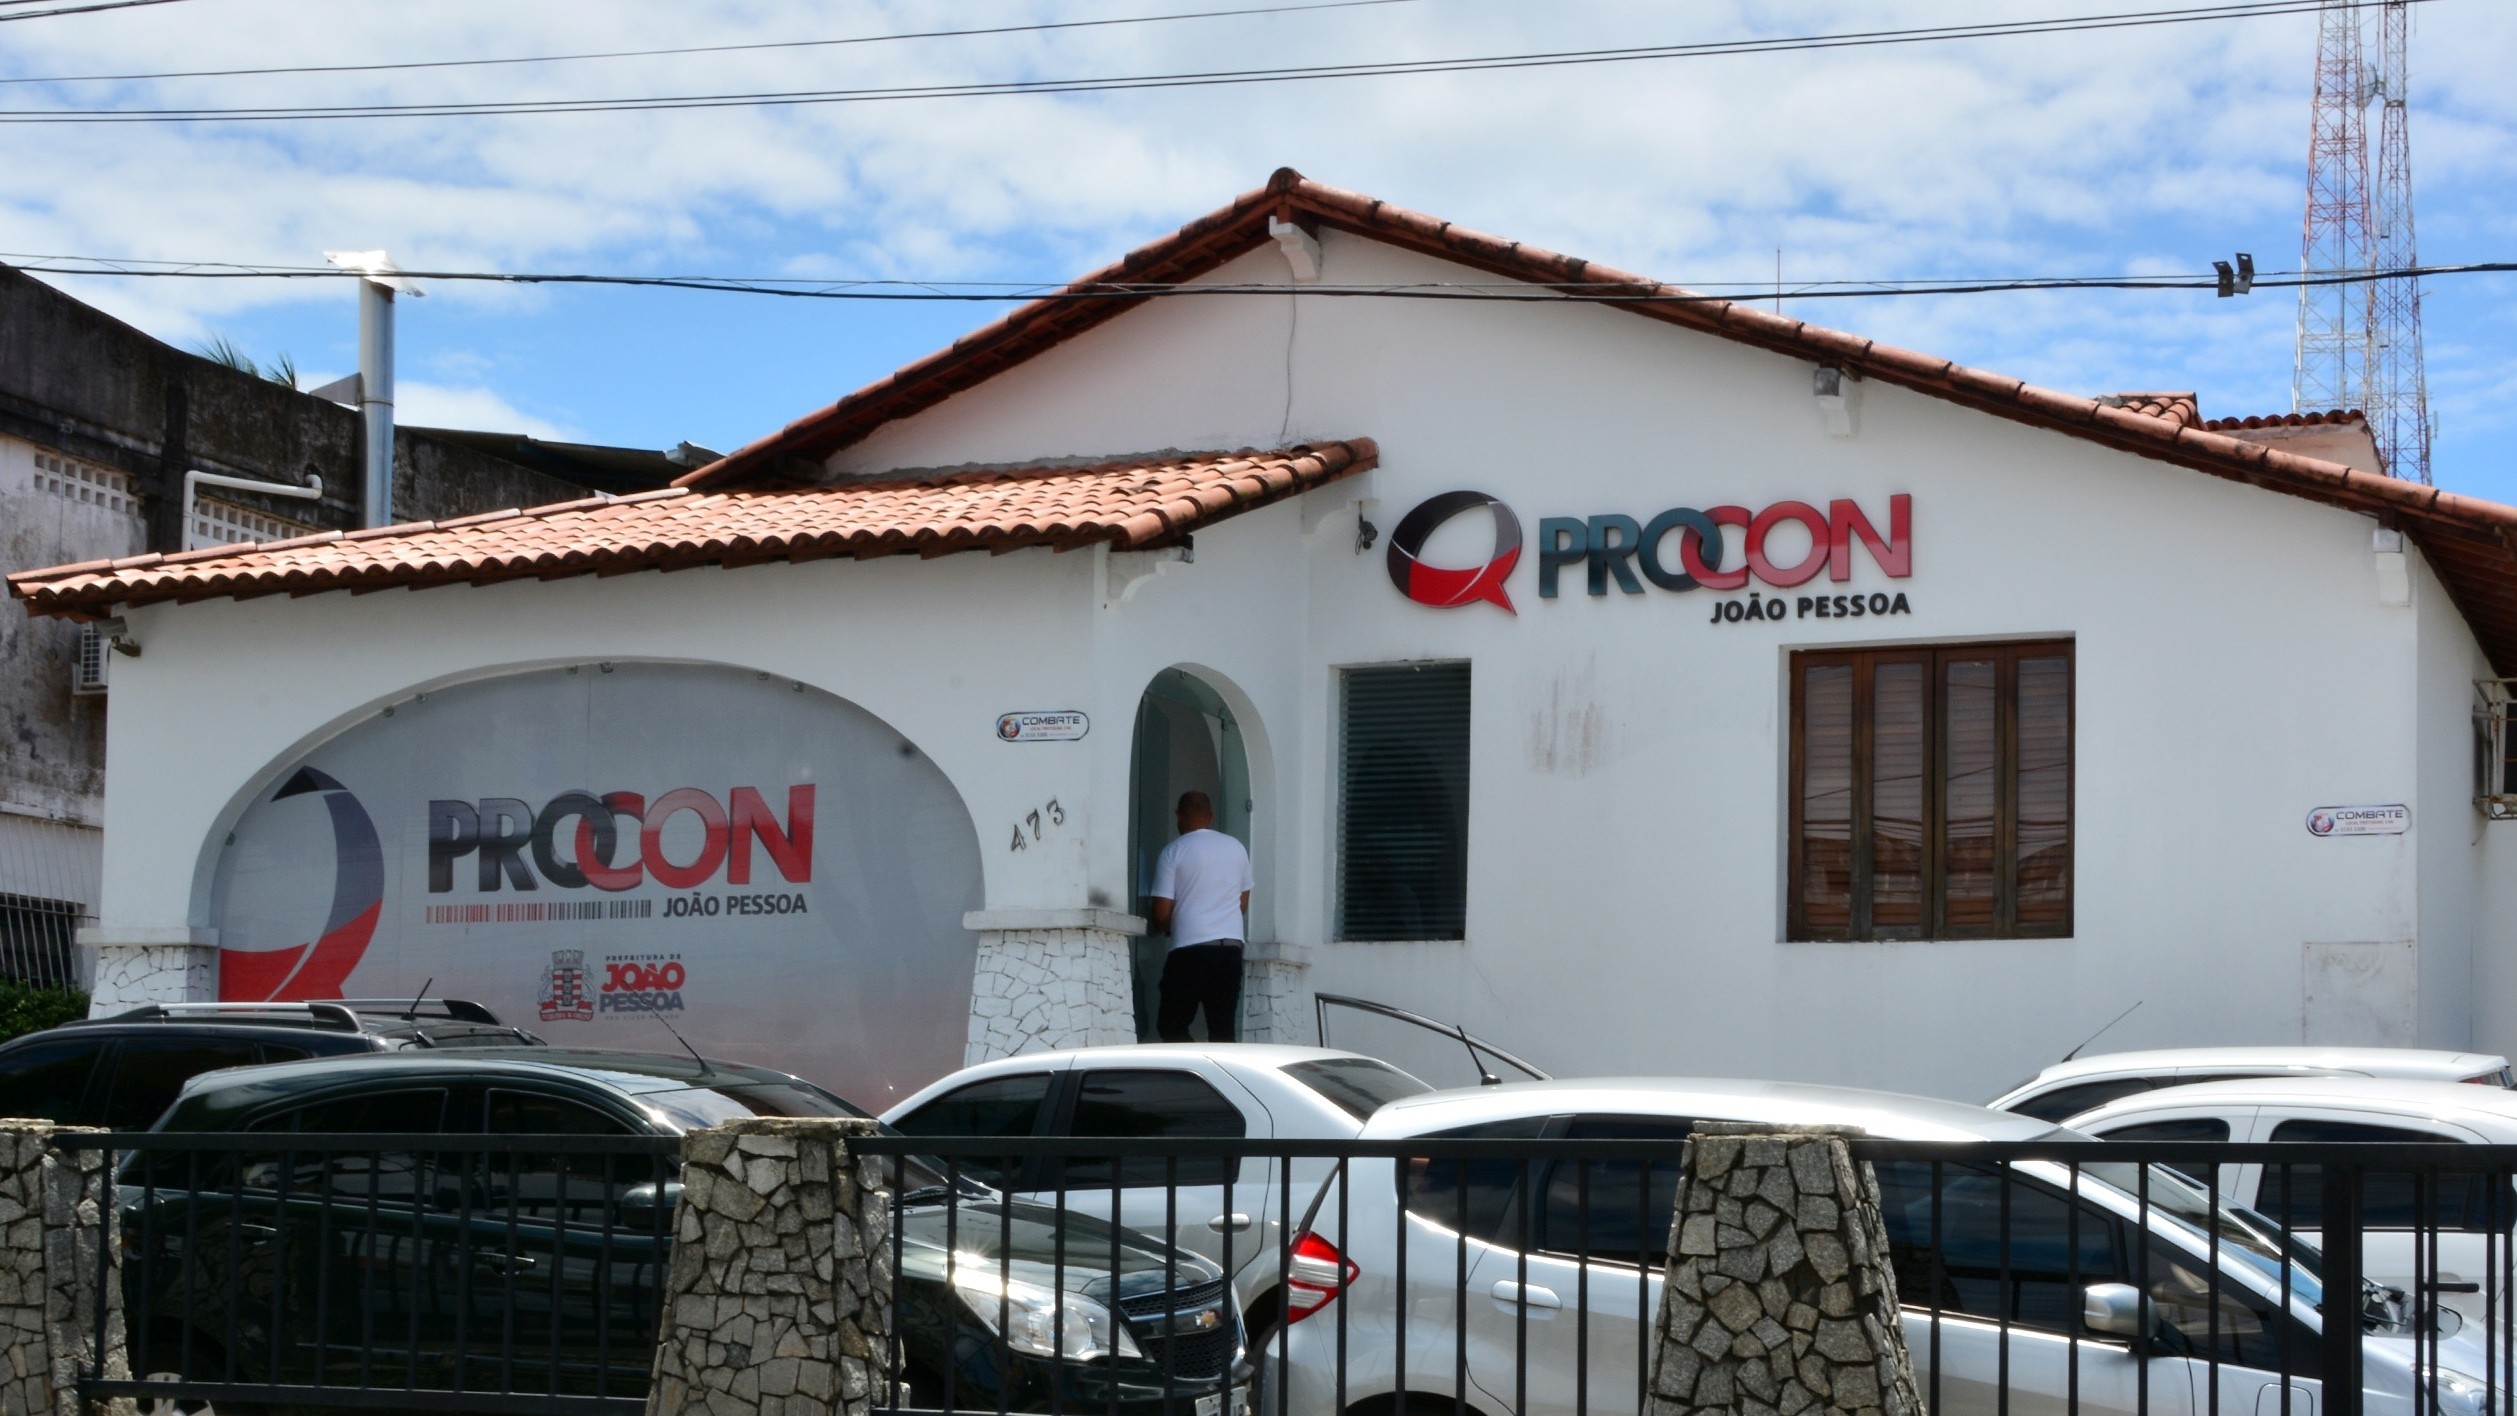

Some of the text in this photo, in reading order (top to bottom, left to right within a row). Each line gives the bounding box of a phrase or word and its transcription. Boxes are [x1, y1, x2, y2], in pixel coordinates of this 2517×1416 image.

[1538, 493, 1913, 599] PROCON
[1710, 592, 1912, 624] JOÃO PESSOA
[1021, 716, 1081, 726] COMBATE
[1010, 798, 1064, 852] 473
[2336, 810, 2404, 820] COMBATE
[428, 783, 816, 893] PROCON
[663, 892, 808, 918] JOÃO PESSOA
[606, 953, 682, 962] PREFEITURA DE
[601, 961, 686, 993] JOÃO
[599, 991, 685, 1013] PESSOA
